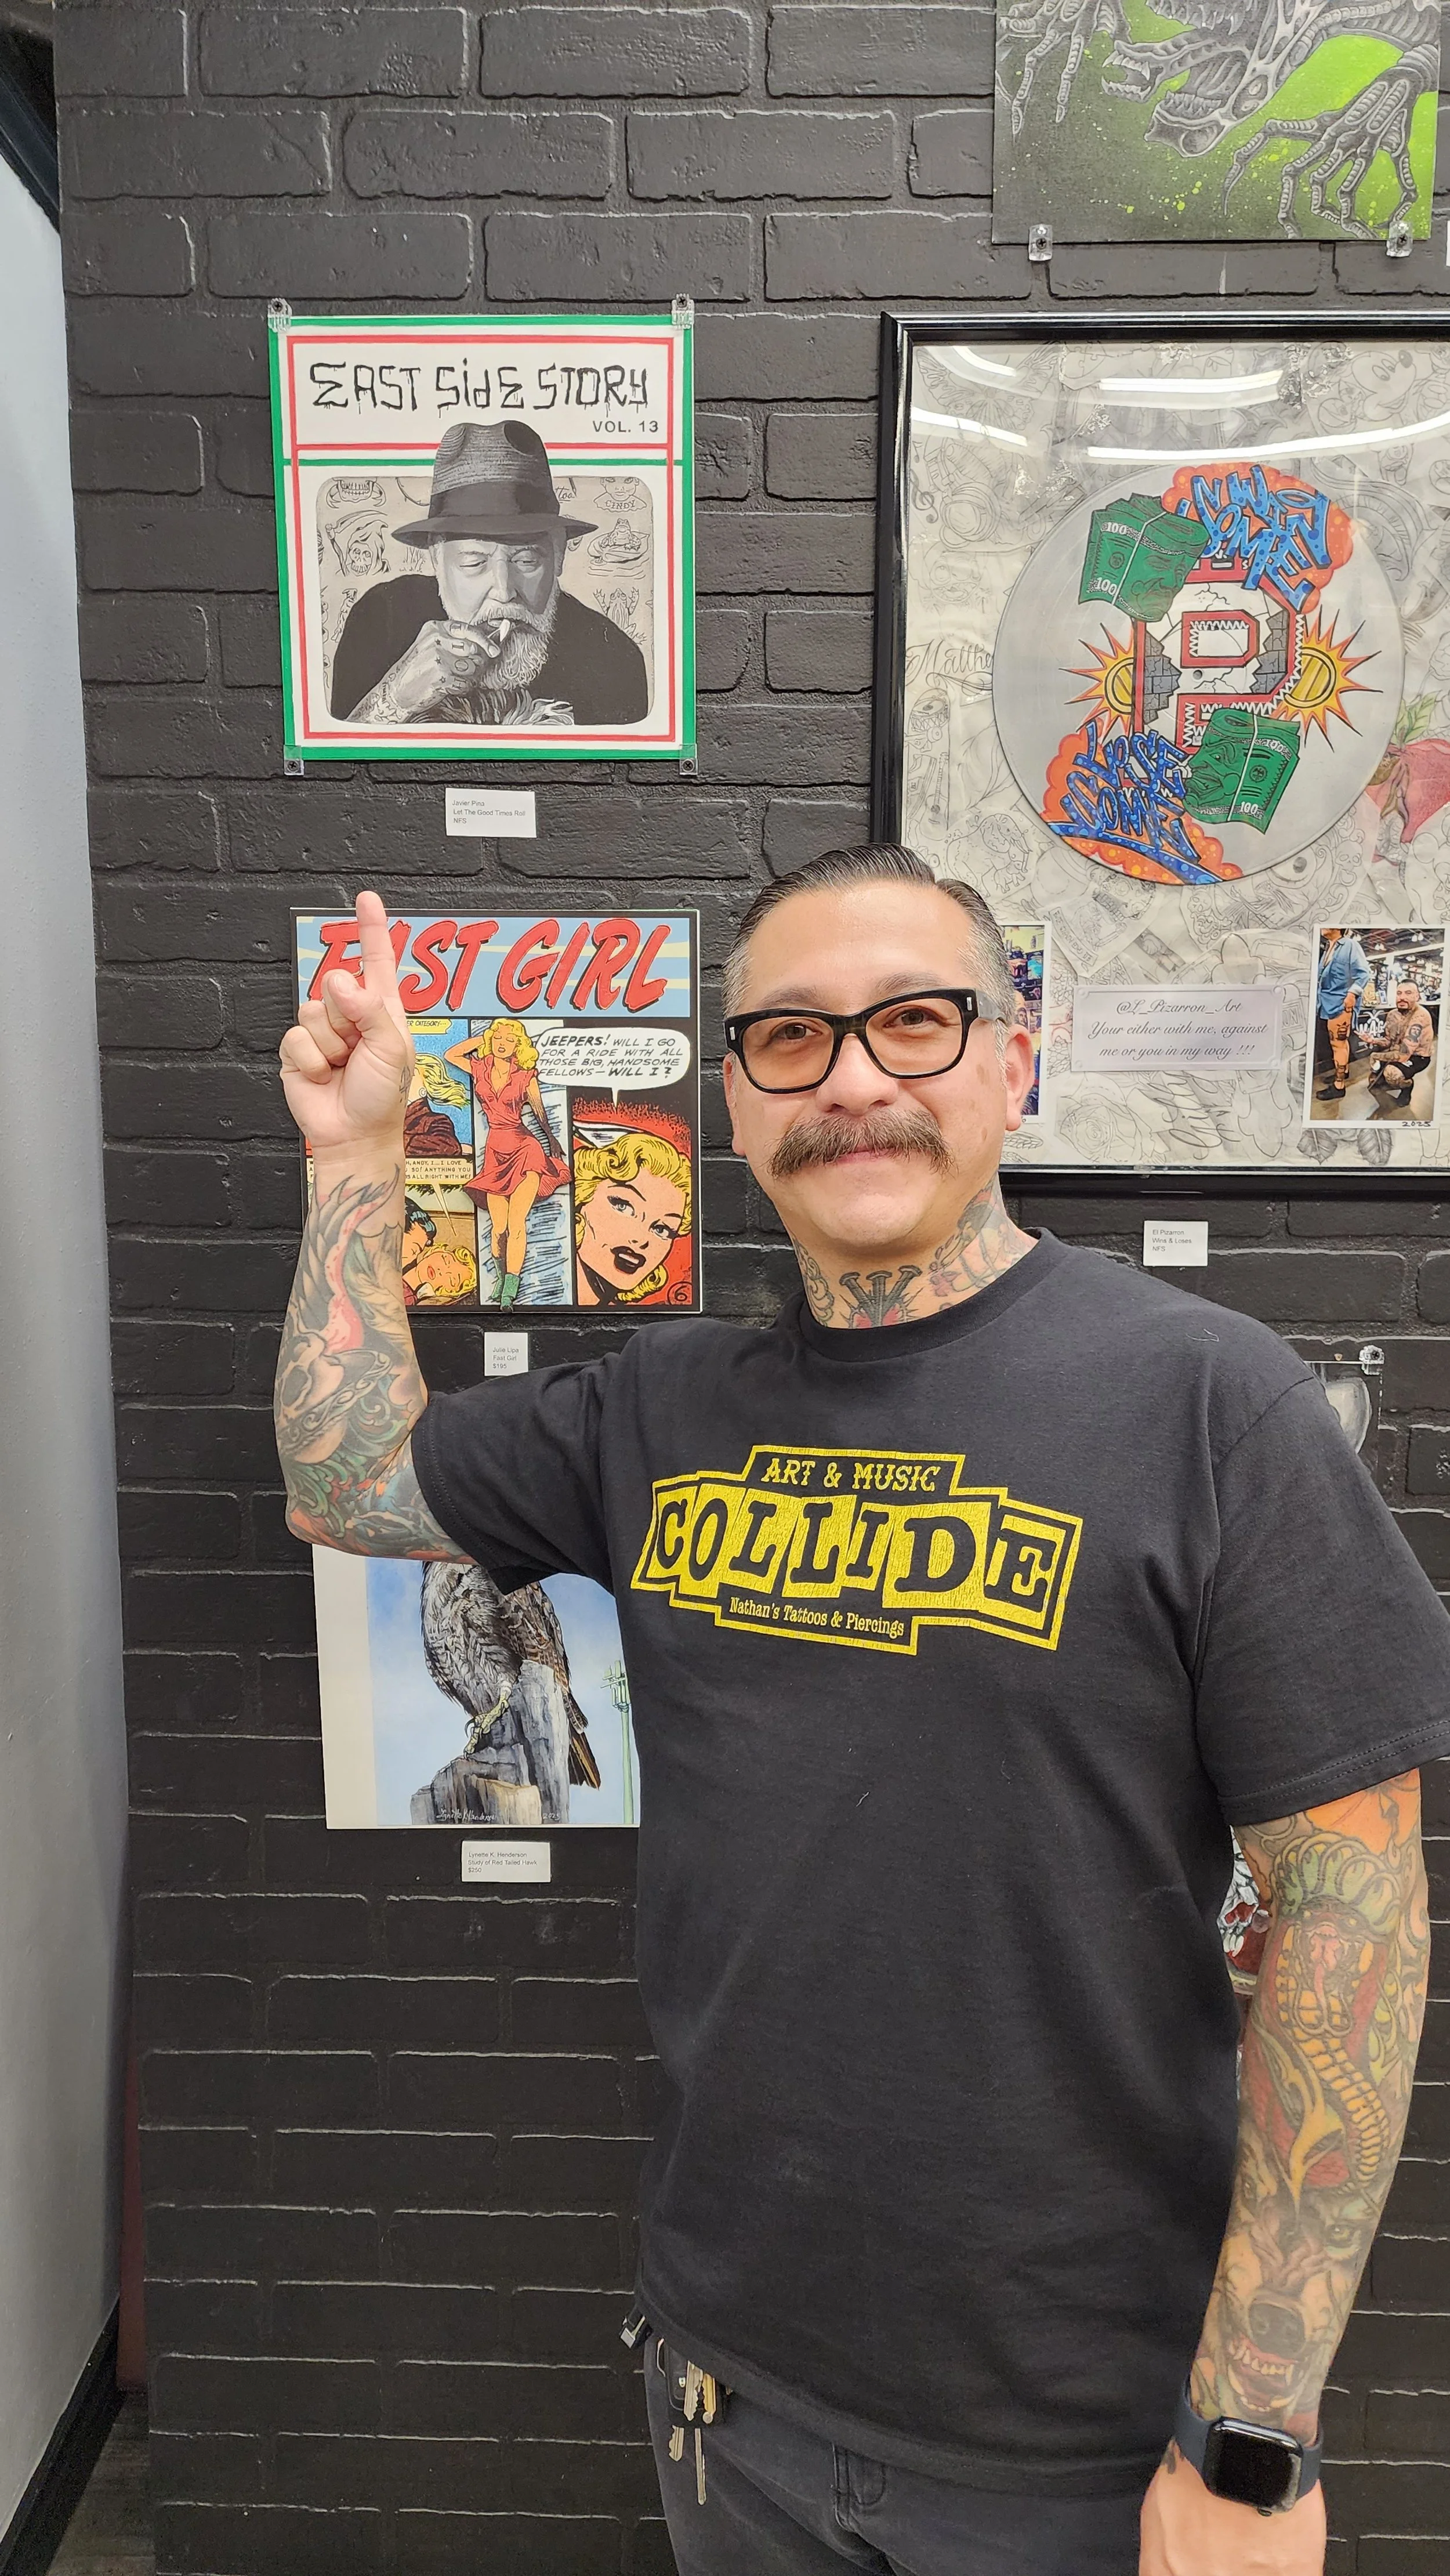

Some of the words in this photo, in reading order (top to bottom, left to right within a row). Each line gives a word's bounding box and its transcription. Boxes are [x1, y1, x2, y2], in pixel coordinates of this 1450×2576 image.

[310, 361, 422, 413] EAST
[533, 362, 648, 413] STORY
[592, 420, 631, 433] VOL.
[638, 419, 659, 433] 13
[1107, 522, 1127, 535] 100
[1096, 576, 1118, 595] 100
[906, 639, 993, 687] Matthe
[1240, 801, 1258, 815] 100
[307, 920, 499, 1014] FST
[497, 920, 670, 1014] GIRL
[1088, 1021, 1124, 1040] Your
[1126, 1023, 1161, 1034] either
[1163, 1021, 1192, 1034] with
[1195, 1026, 1216, 1035] me,
[1221, 1023, 1267, 1038] against
[541, 1034, 611, 1047] JEEPERS!
[613, 1039, 639, 1047] WILL
[658, 1038, 675, 1047] GO
[624, 1048, 654, 1057] WITH
[659, 1048, 683, 1056] ALL
[1099, 1048, 1119, 1056] me
[1121, 1048, 1136, 1056] or
[1132, 1047, 1165, 1061] you
[1165, 1045, 1177, 1056] in
[1180, 1047, 1201, 1061] my
[1204, 1047, 1232, 1061] way
[1236, 1045, 1255, 1055] !!!
[608, 1067, 643, 1076] WILL
[674, 1285, 688, 1302] 6
[760, 1458, 815, 1486] ART
[823, 1462, 842, 1488] &
[852, 1463, 941, 1492] MUSIC
[656, 1499, 1056, 1612] COLLIDE
[729, 1597, 780, 1619] Nathan's
[784, 1605, 828, 1626] Tattoos
[831, 1611, 843, 1627] &
[846, 1613, 904, 1639] Piercings
